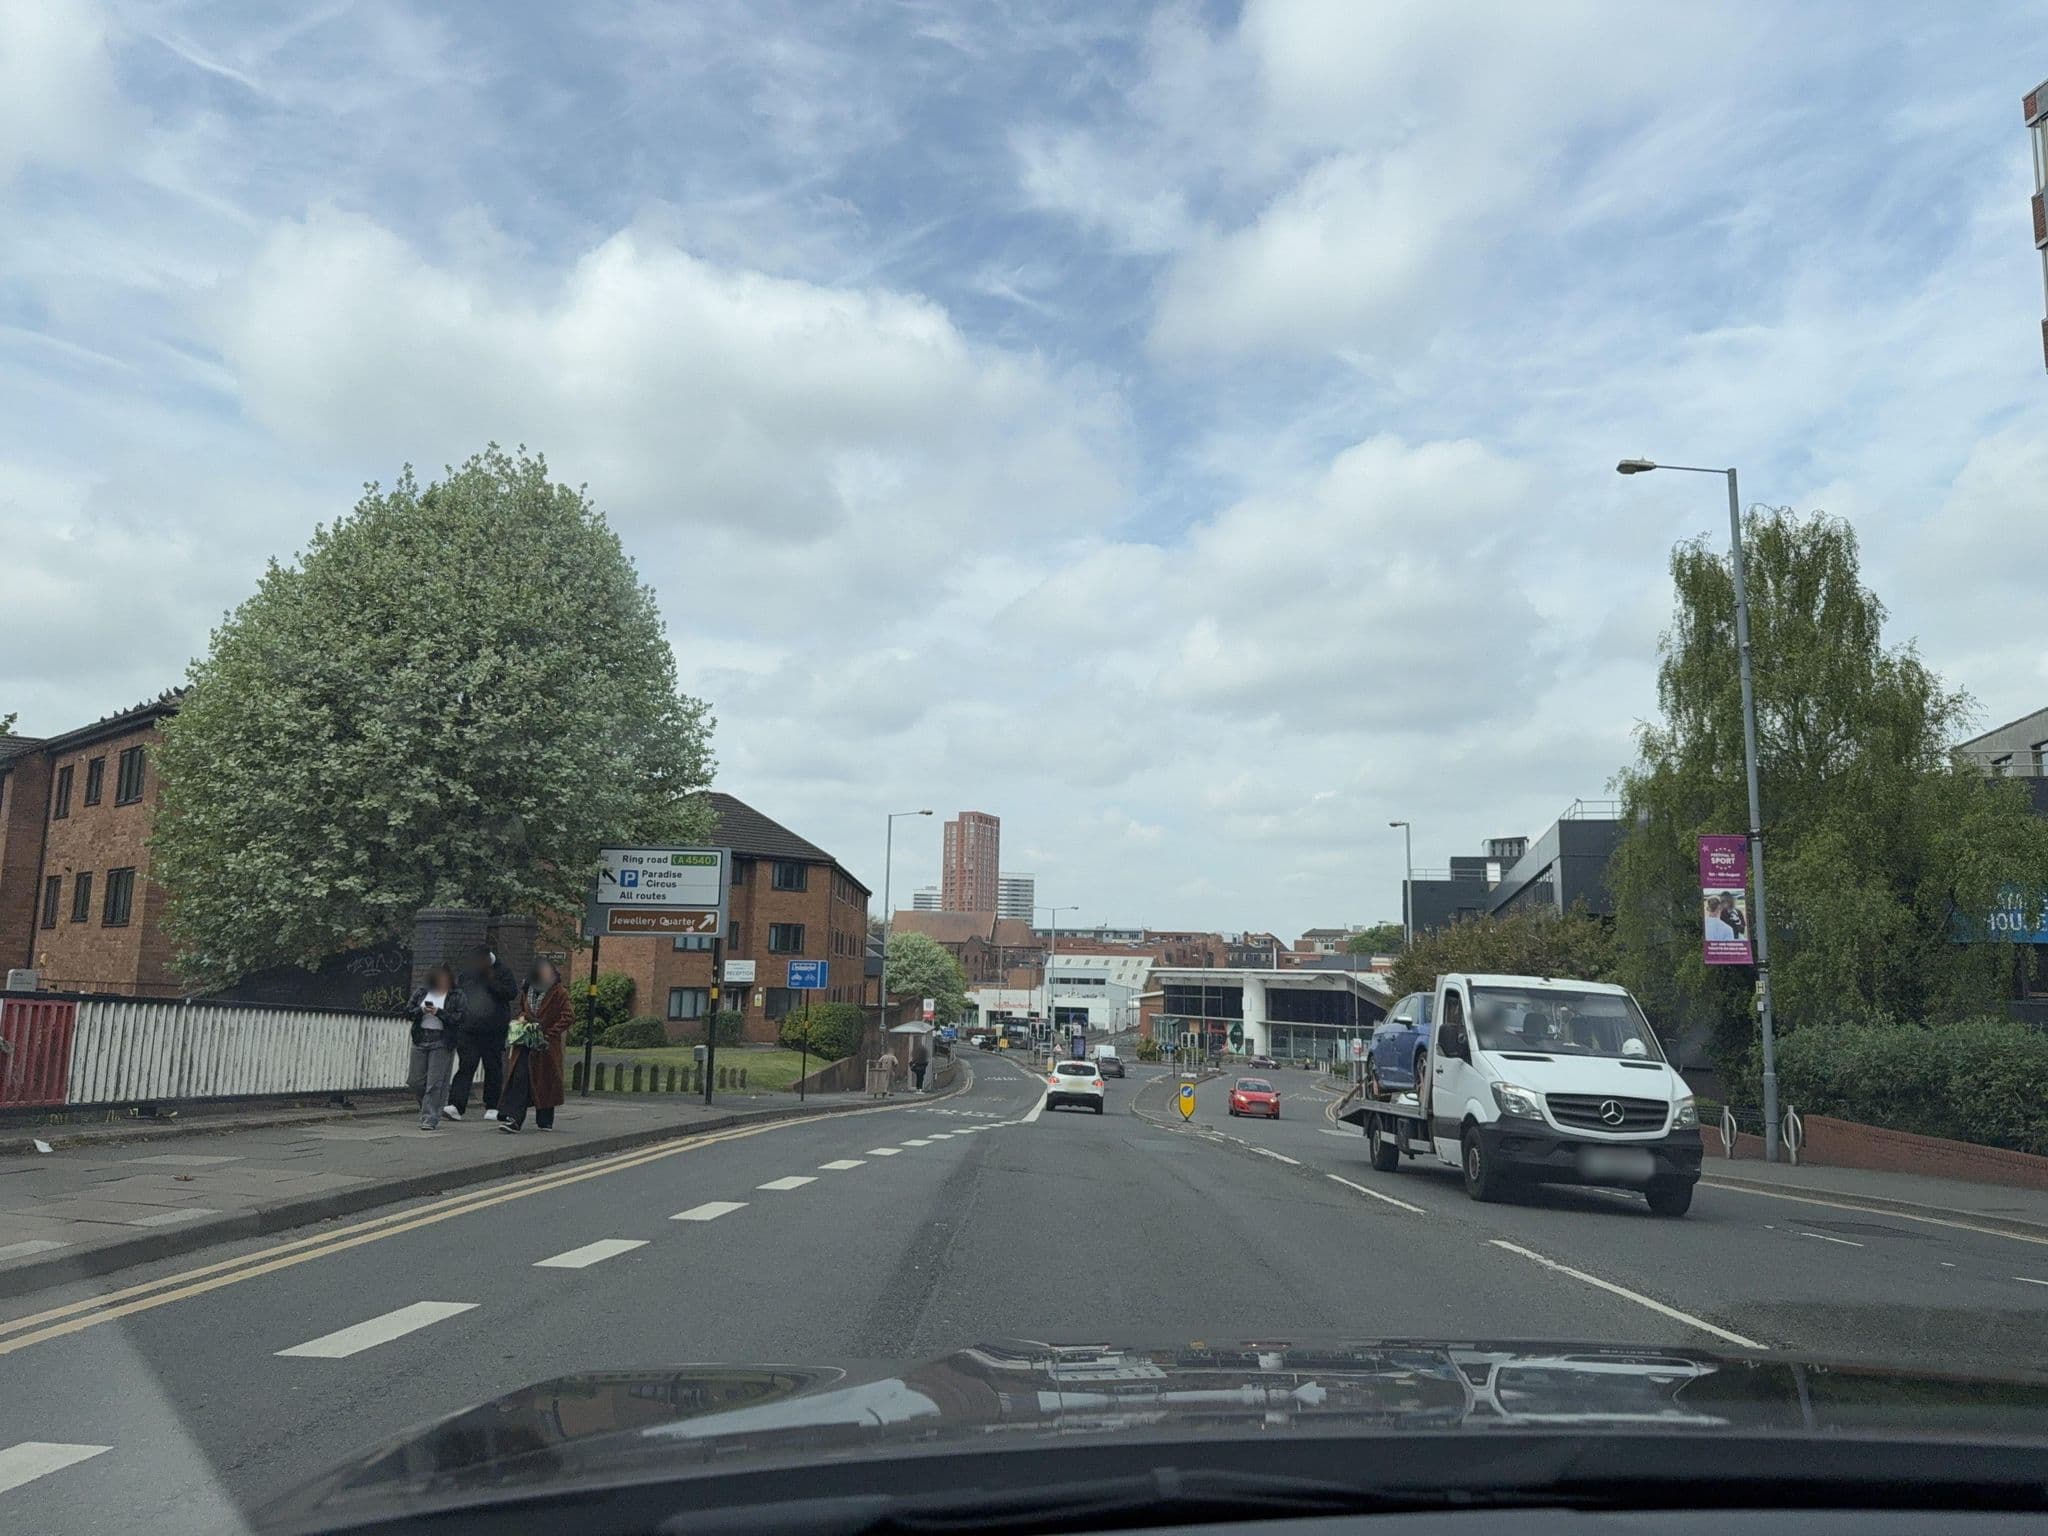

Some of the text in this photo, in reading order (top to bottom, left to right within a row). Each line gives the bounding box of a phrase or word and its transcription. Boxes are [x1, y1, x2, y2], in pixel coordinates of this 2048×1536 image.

[622, 855, 644, 864] Ring
[647, 855, 668, 864] road
[1710, 857, 1735, 865] SPORT
[624, 870, 682, 886] P Paradise
[646, 880, 677, 888] Circus
[619, 891, 666, 900] All routes
[612, 916, 696, 927] Jewellery Quarter
[1757, 983, 1764, 993] H
